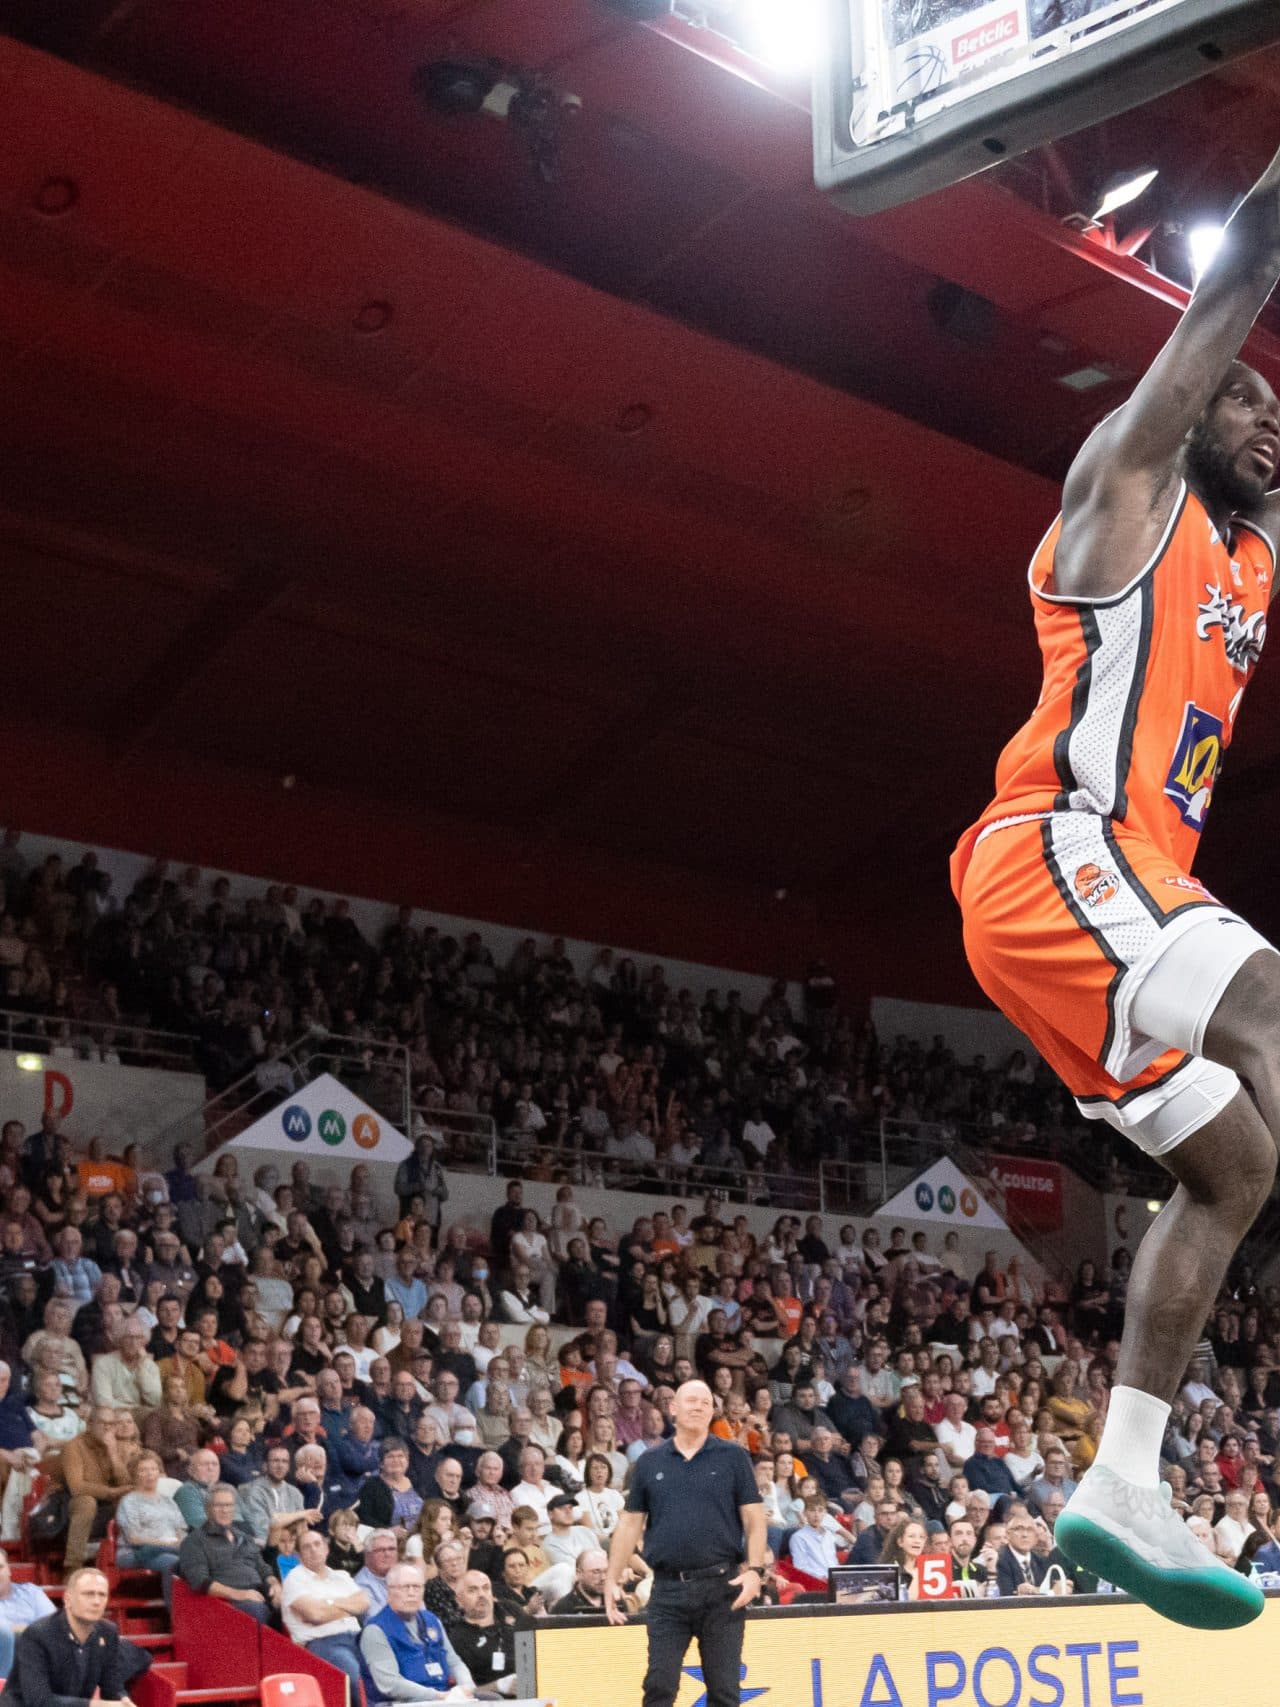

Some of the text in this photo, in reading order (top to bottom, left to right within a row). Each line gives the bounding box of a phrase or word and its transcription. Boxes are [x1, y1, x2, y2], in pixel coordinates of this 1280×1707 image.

[958, 20, 1014, 58] Betclic
[44, 1070, 73, 1119] D
[1002, 1172, 1054, 1192] course
[922, 1560, 948, 1596] 5
[925, 1640, 1144, 1707] POSTE
